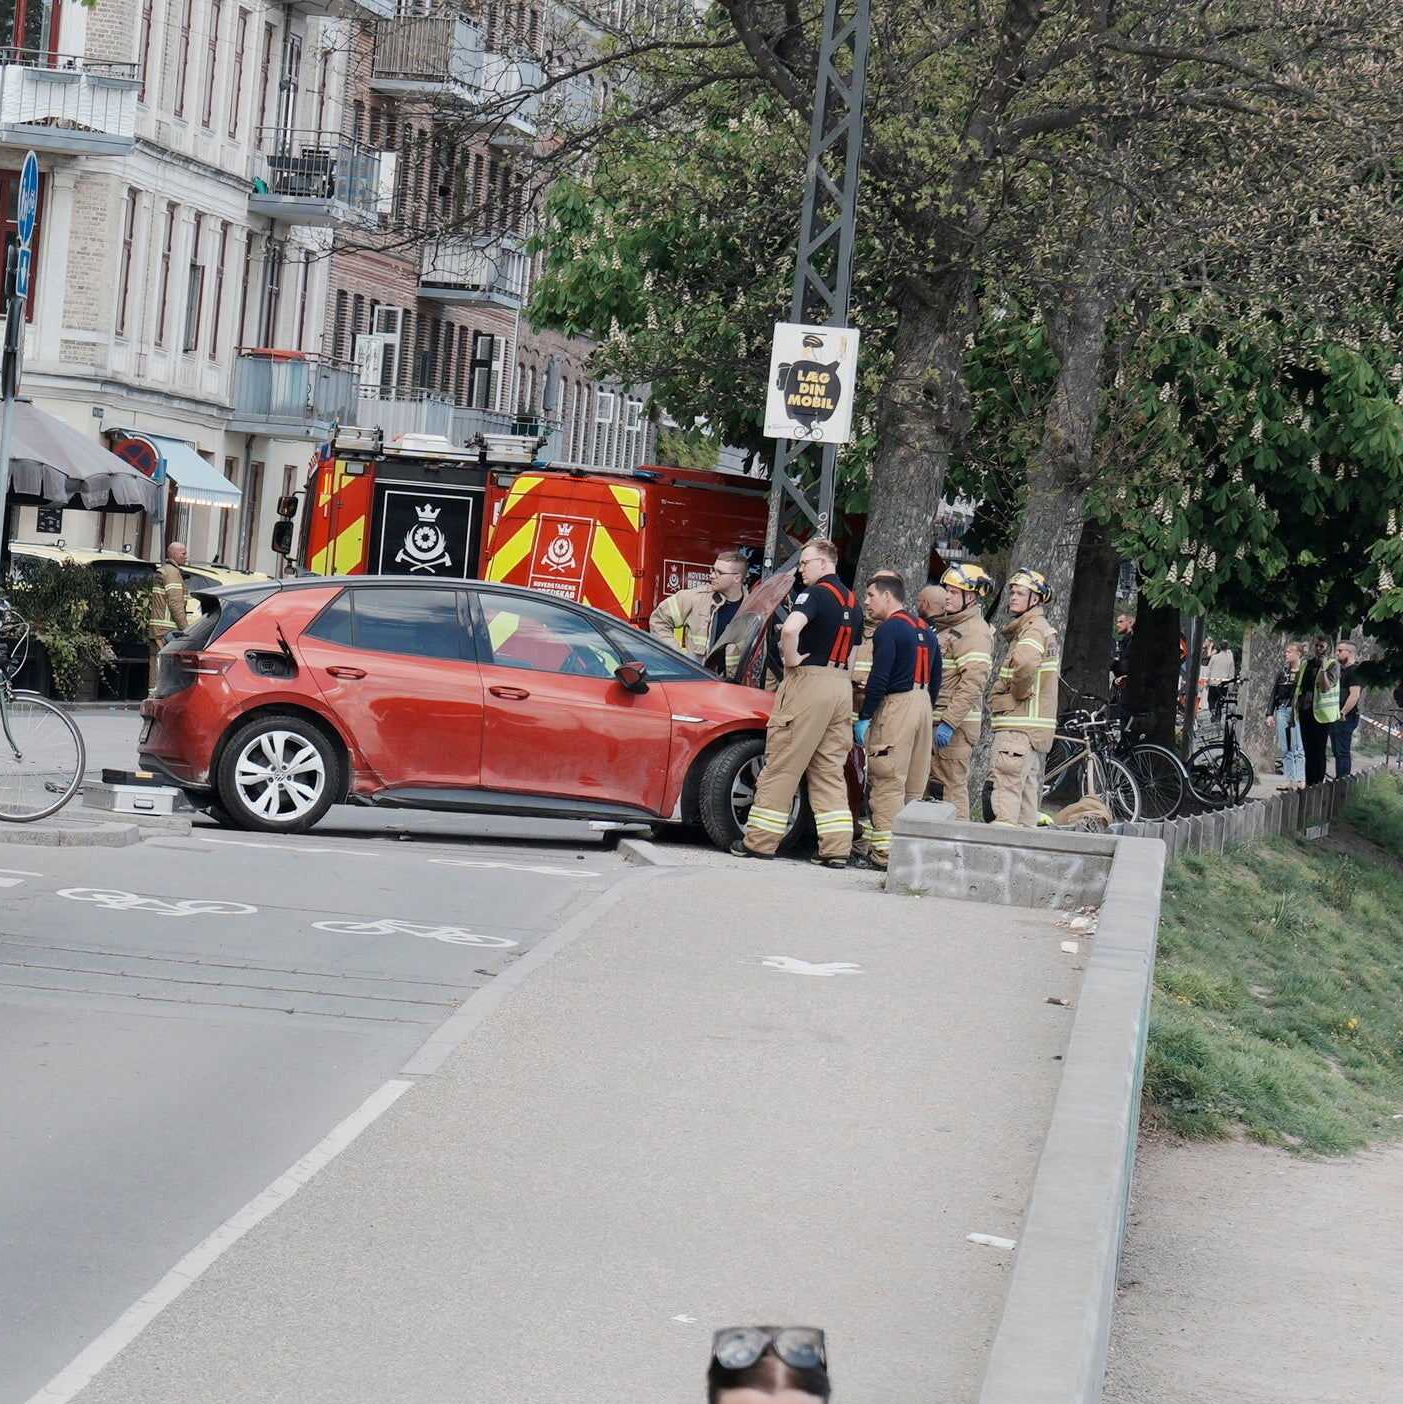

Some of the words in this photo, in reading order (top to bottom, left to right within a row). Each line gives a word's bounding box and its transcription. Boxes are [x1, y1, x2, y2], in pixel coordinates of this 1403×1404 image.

[797, 369, 831, 384] LÆG
[798, 382, 826, 396] DIN
[787, 393, 834, 410] MOBIL
